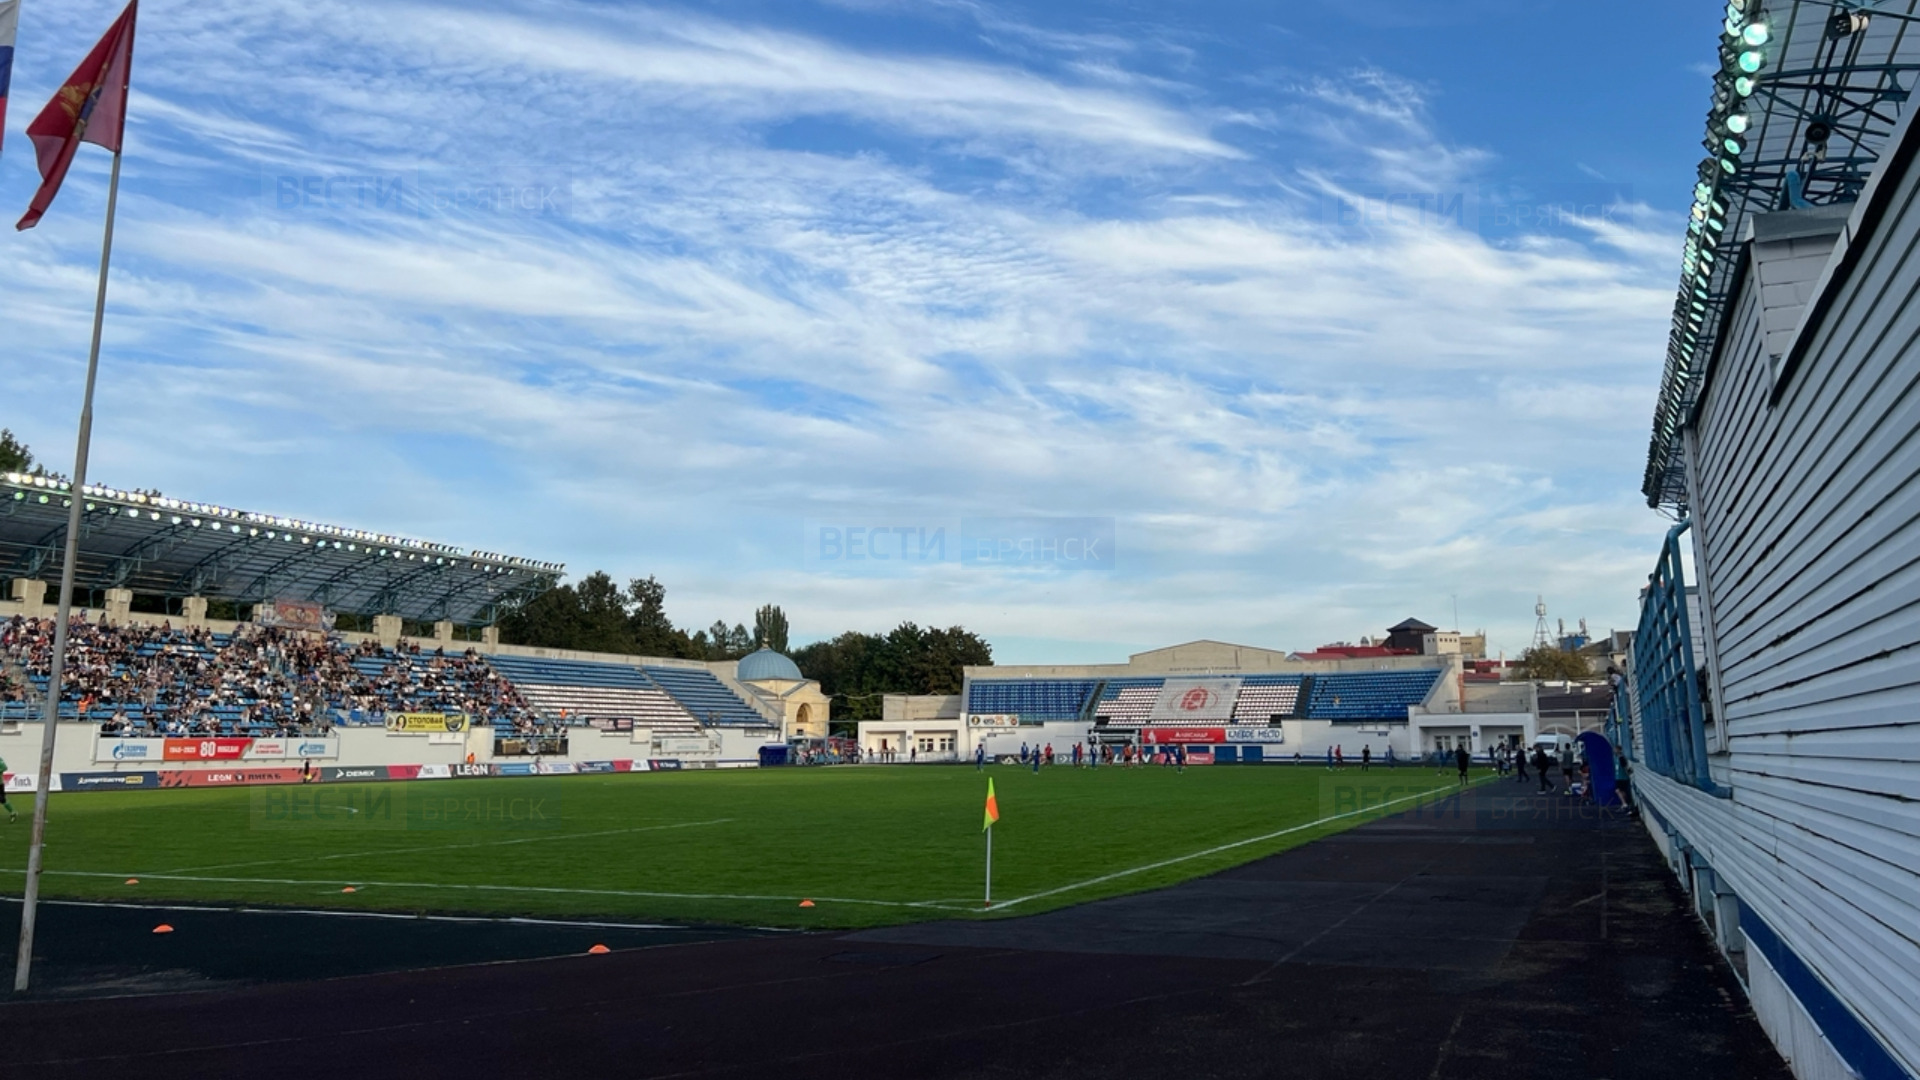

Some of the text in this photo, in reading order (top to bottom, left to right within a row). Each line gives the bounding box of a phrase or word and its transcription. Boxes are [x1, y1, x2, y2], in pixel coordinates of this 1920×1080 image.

[200, 741, 216, 757] 80
[345, 769, 376, 777] DEMIX
[457, 764, 489, 776] LEON
